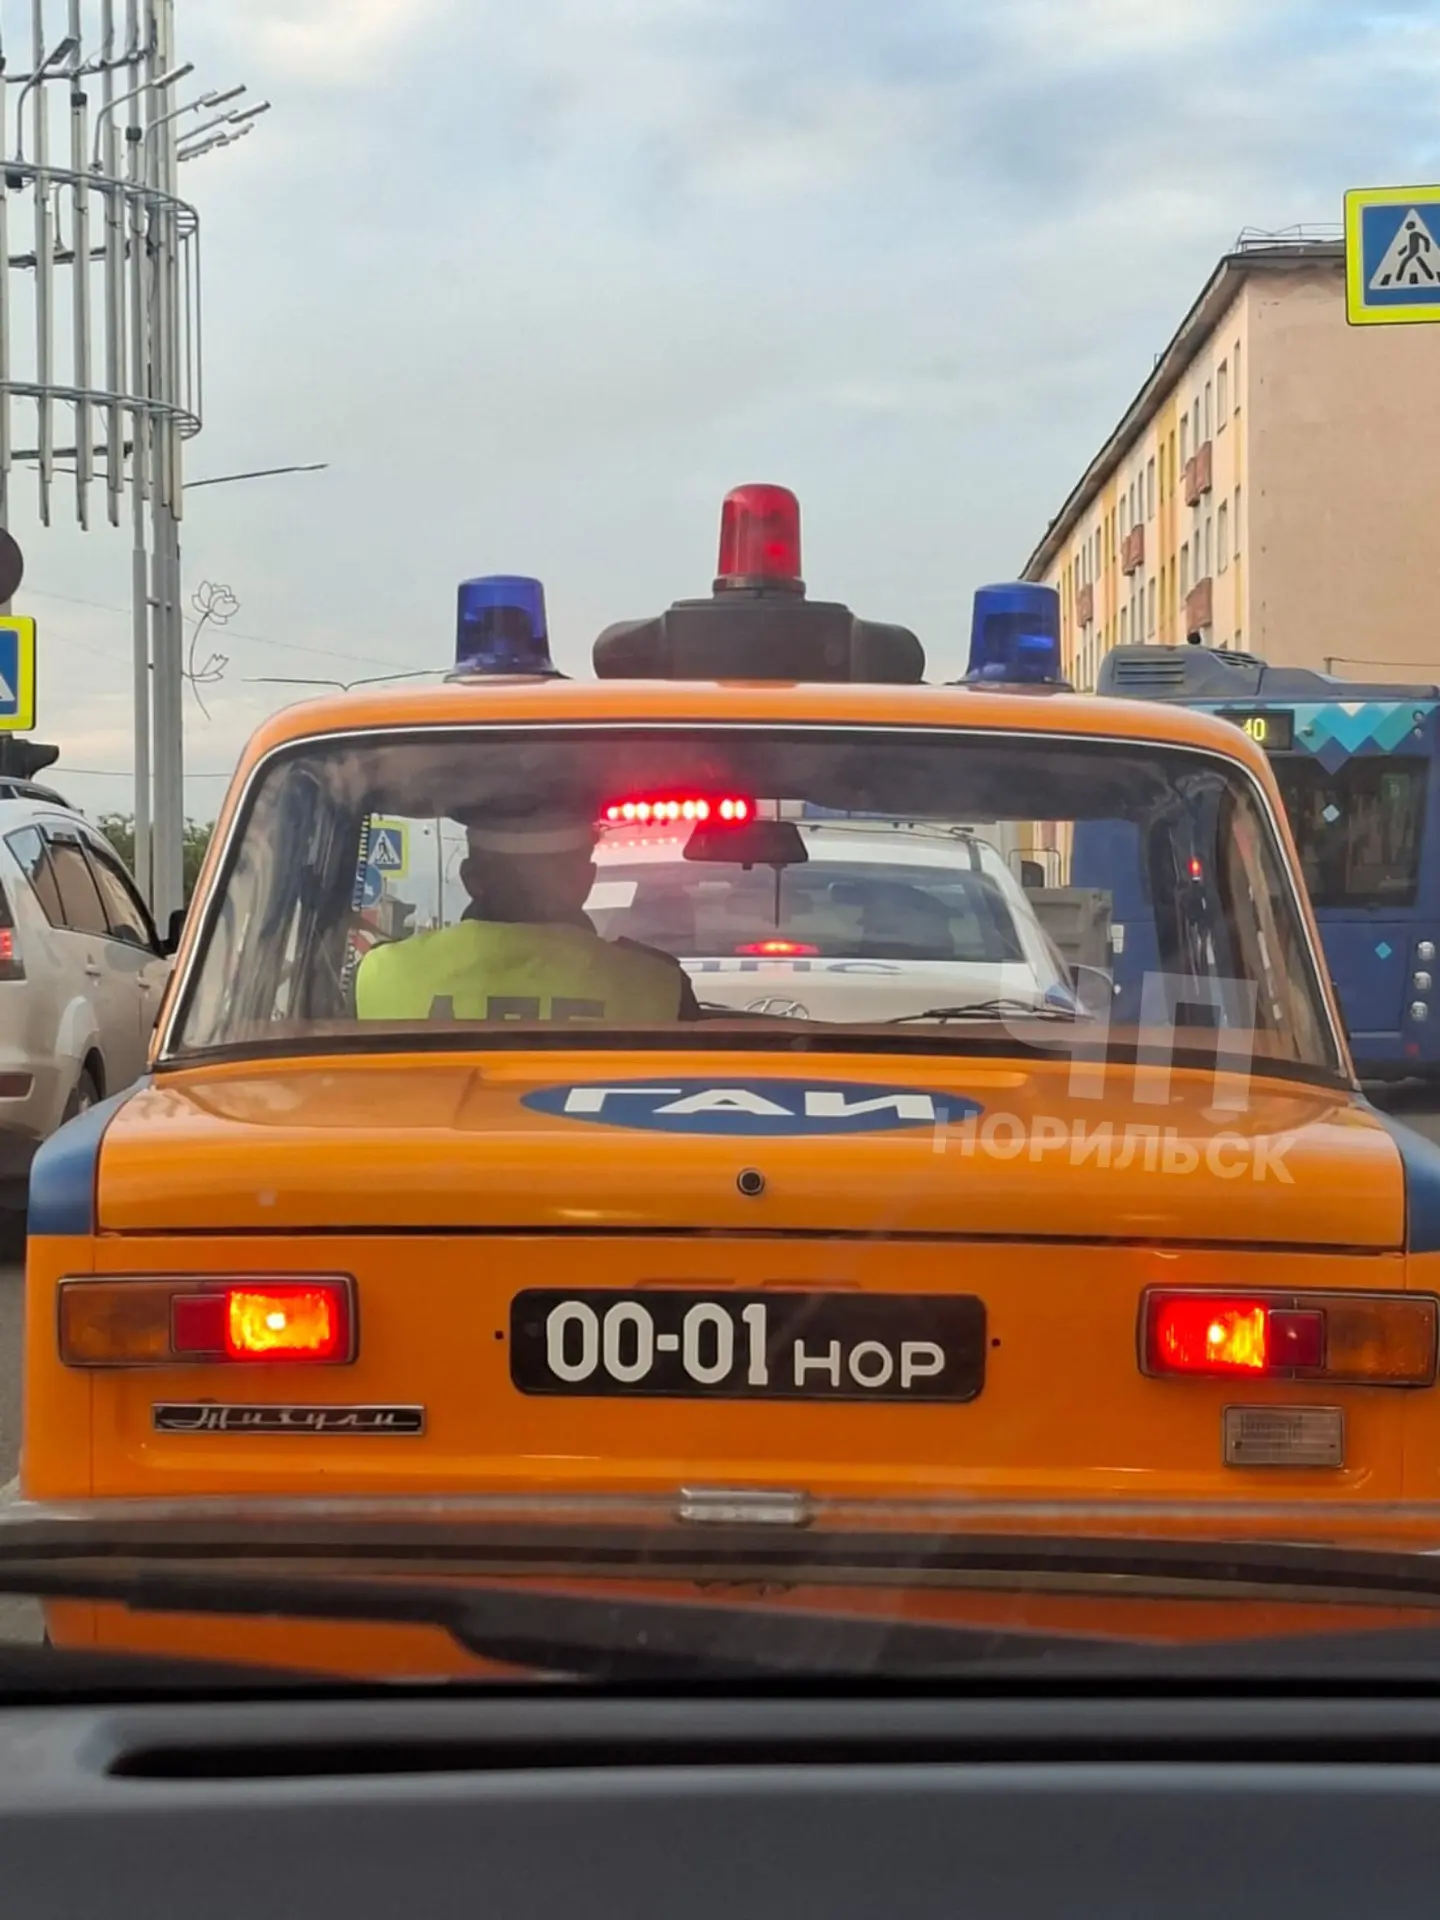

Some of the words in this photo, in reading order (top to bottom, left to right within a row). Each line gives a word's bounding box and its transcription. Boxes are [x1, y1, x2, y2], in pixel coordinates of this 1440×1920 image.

[564, 1088, 935, 1120] ГАИ
[546, 1301, 769, 1386] 00-01
[794, 1339, 946, 1388] НОР
